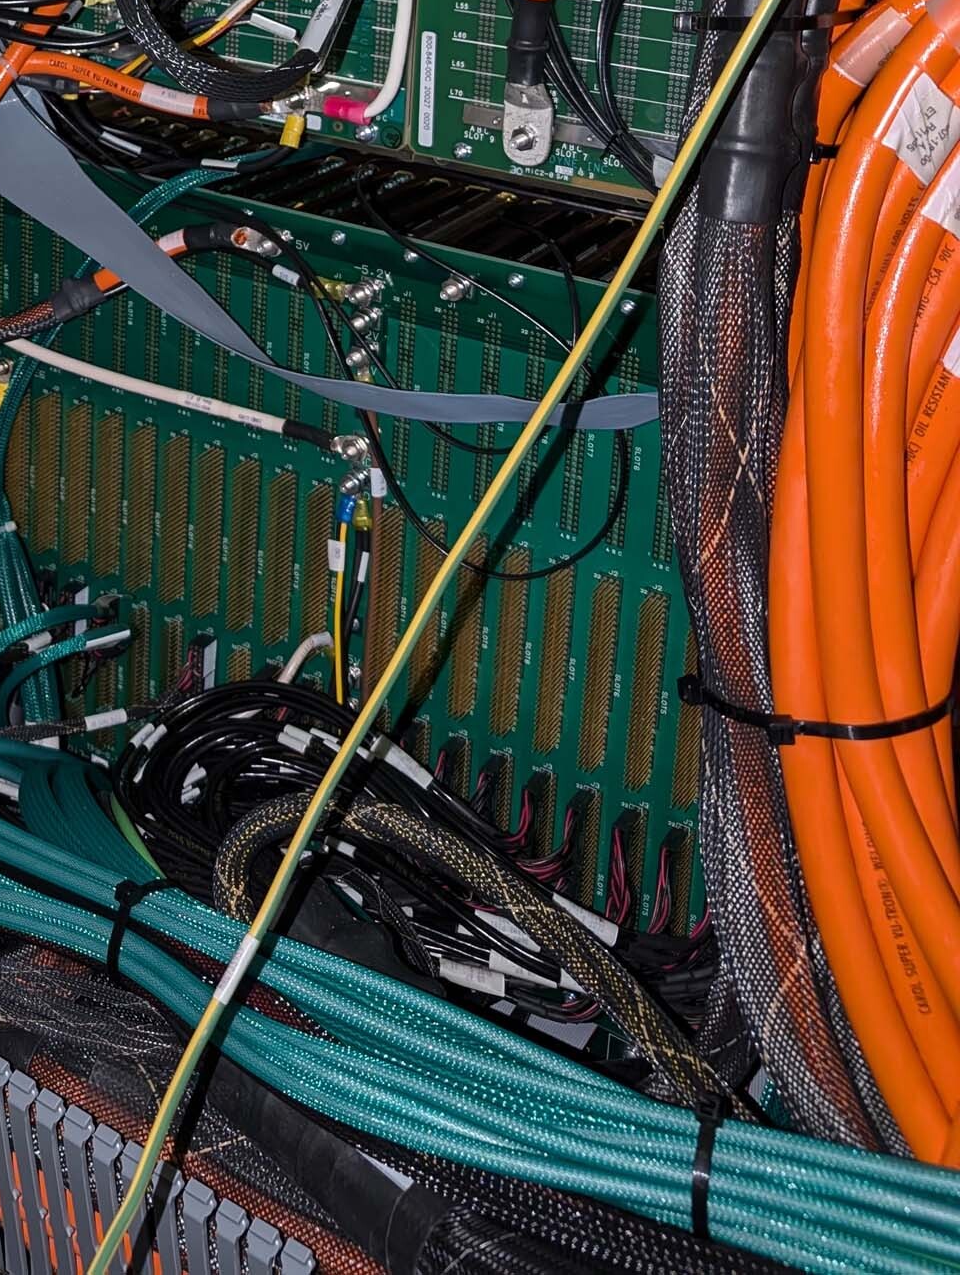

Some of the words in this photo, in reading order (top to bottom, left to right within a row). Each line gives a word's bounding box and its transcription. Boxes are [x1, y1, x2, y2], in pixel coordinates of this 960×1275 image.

[464, 131, 484, 141] SLOT
[555, 149, 577, 158] SLOT
[603, 157, 620, 167] SLO
[295, 239, 310, 251] 5V
[914, 421, 929, 438] OIL
[923, 371, 952, 420] RESISTANT
[587, 433, 595, 458] SLOT7
[568, 657, 576, 682] SLOT7
[613, 673, 622, 697] SLOT6
[660, 690, 669, 715] SLOT5
[597, 873, 605, 896] SLOT6
[642, 894, 650, 916] SLOT5
